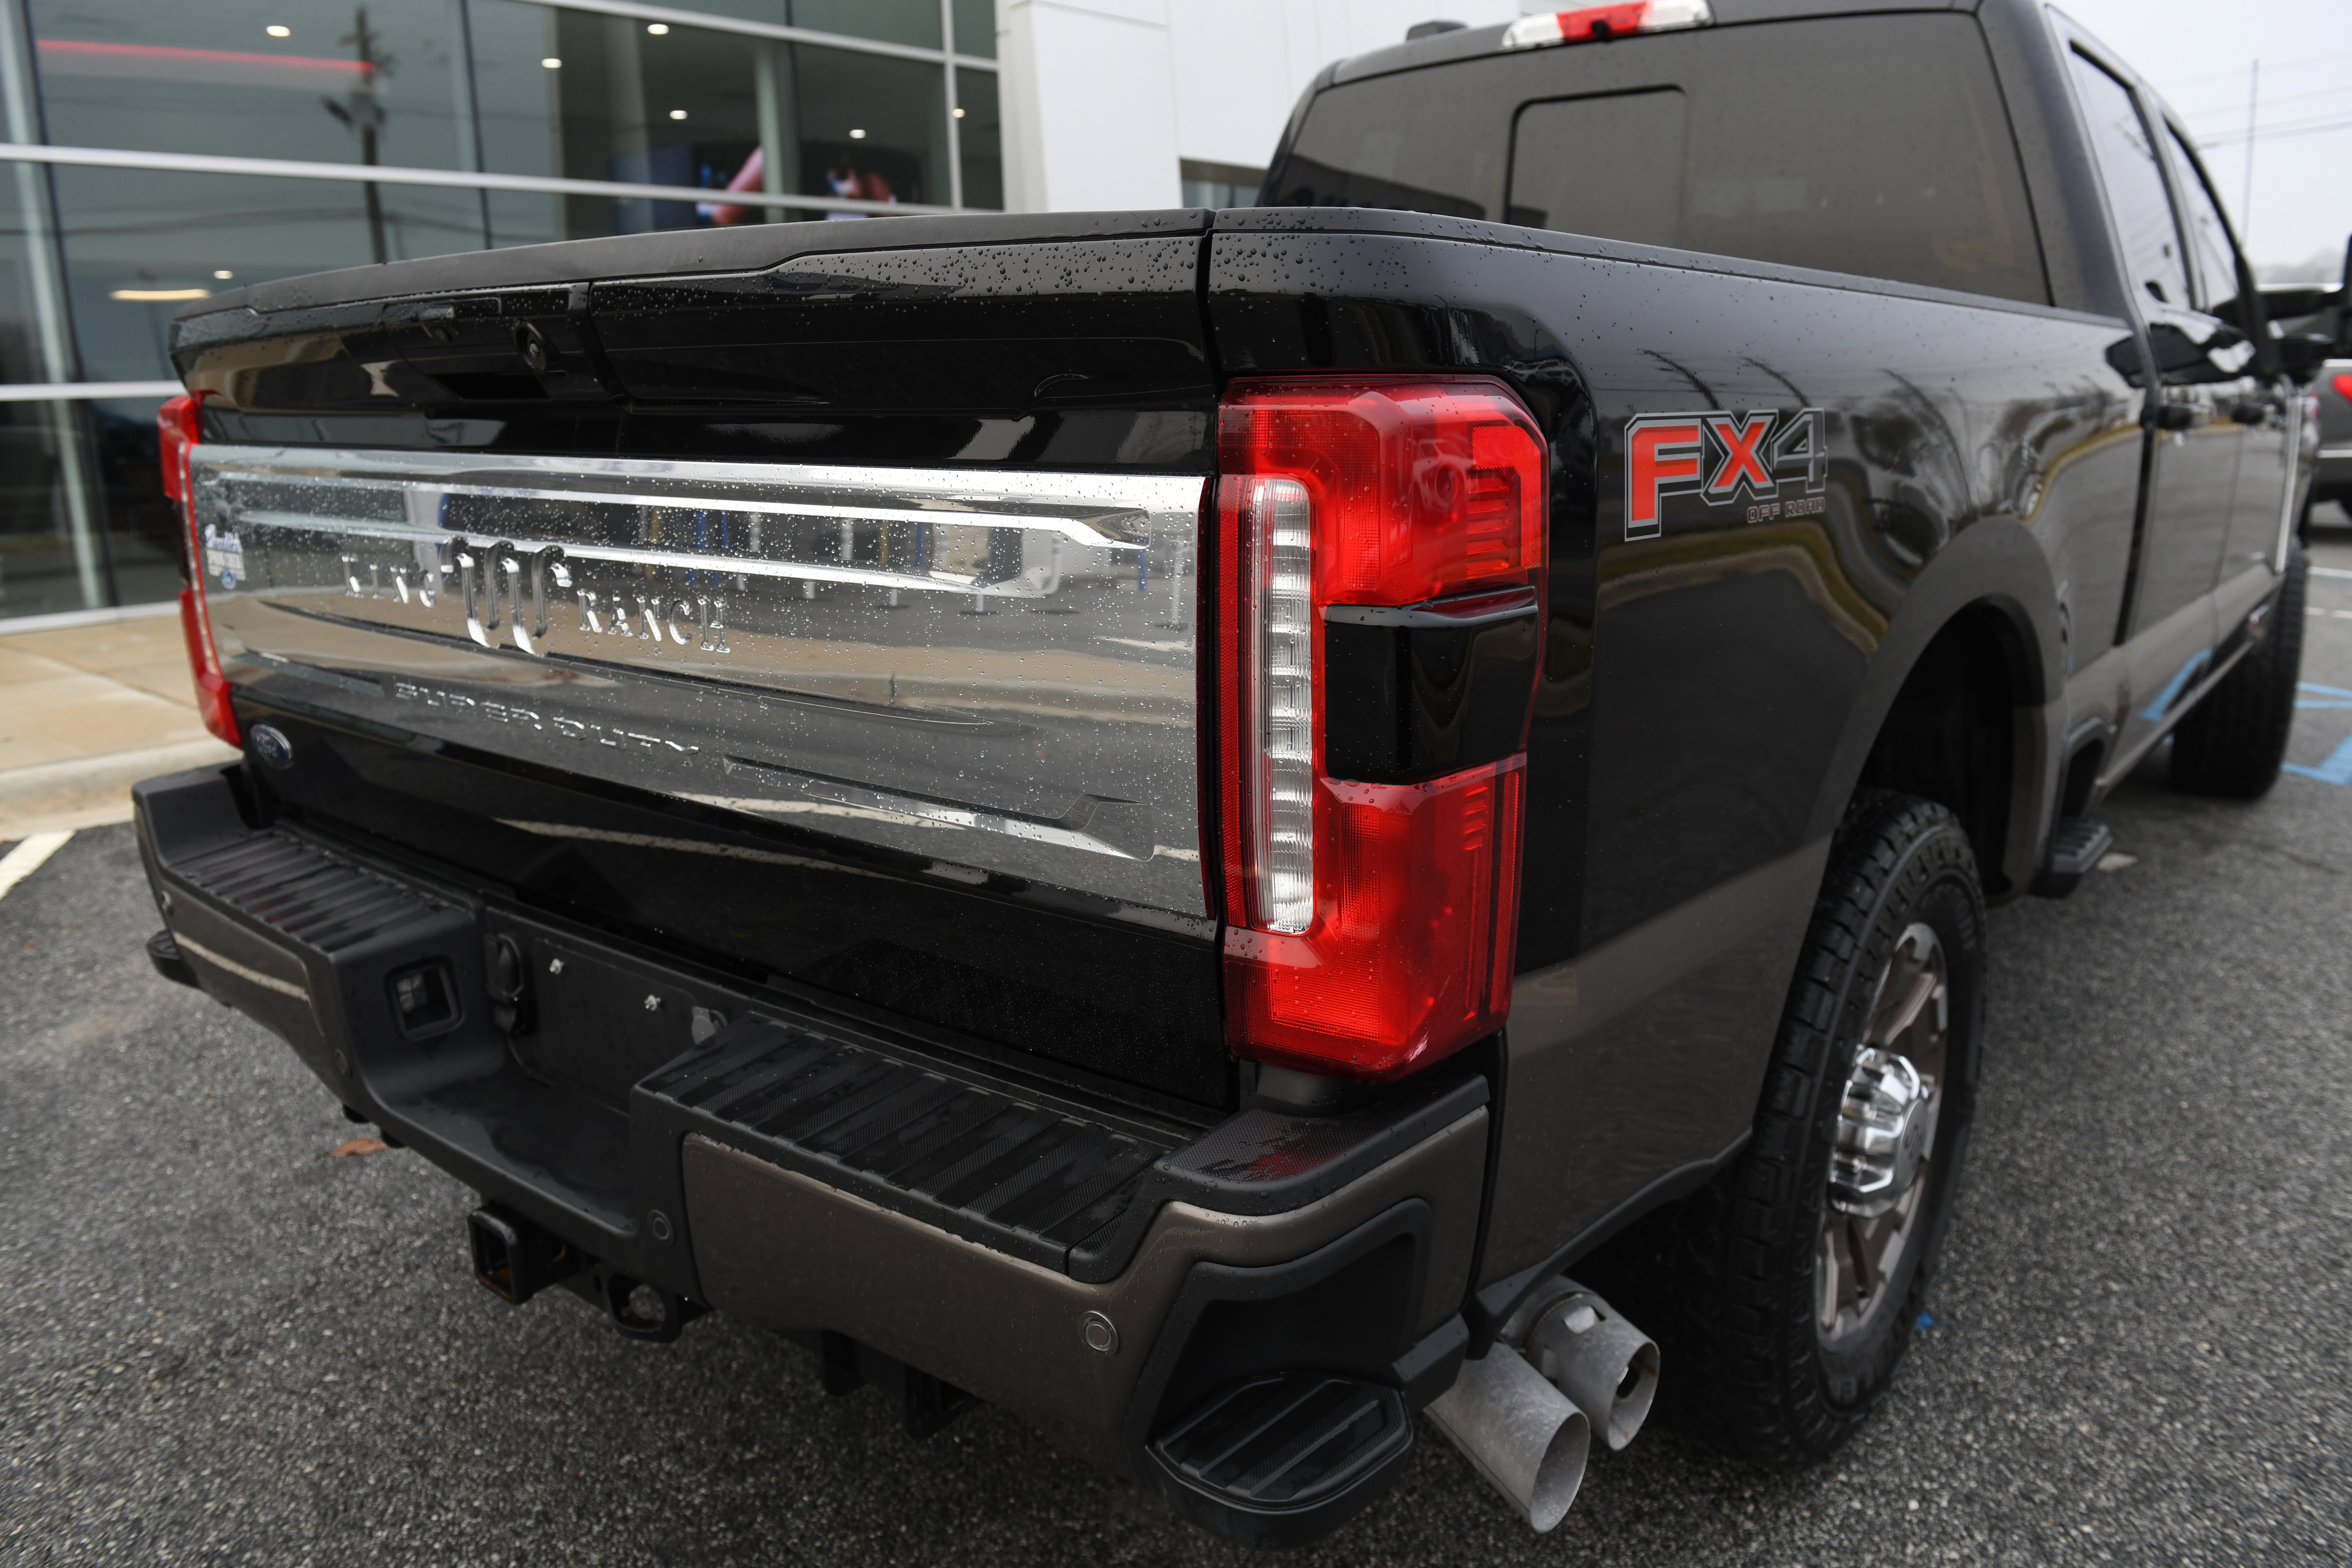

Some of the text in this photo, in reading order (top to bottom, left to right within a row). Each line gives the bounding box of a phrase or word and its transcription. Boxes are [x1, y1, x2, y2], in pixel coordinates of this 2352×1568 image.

[1625, 408, 1827, 542] FX4
[1747, 496, 1826, 523] OFF ROAD
[577, 588, 731, 654] RANCH
[395, 682, 701, 766] SUPER DUTY
